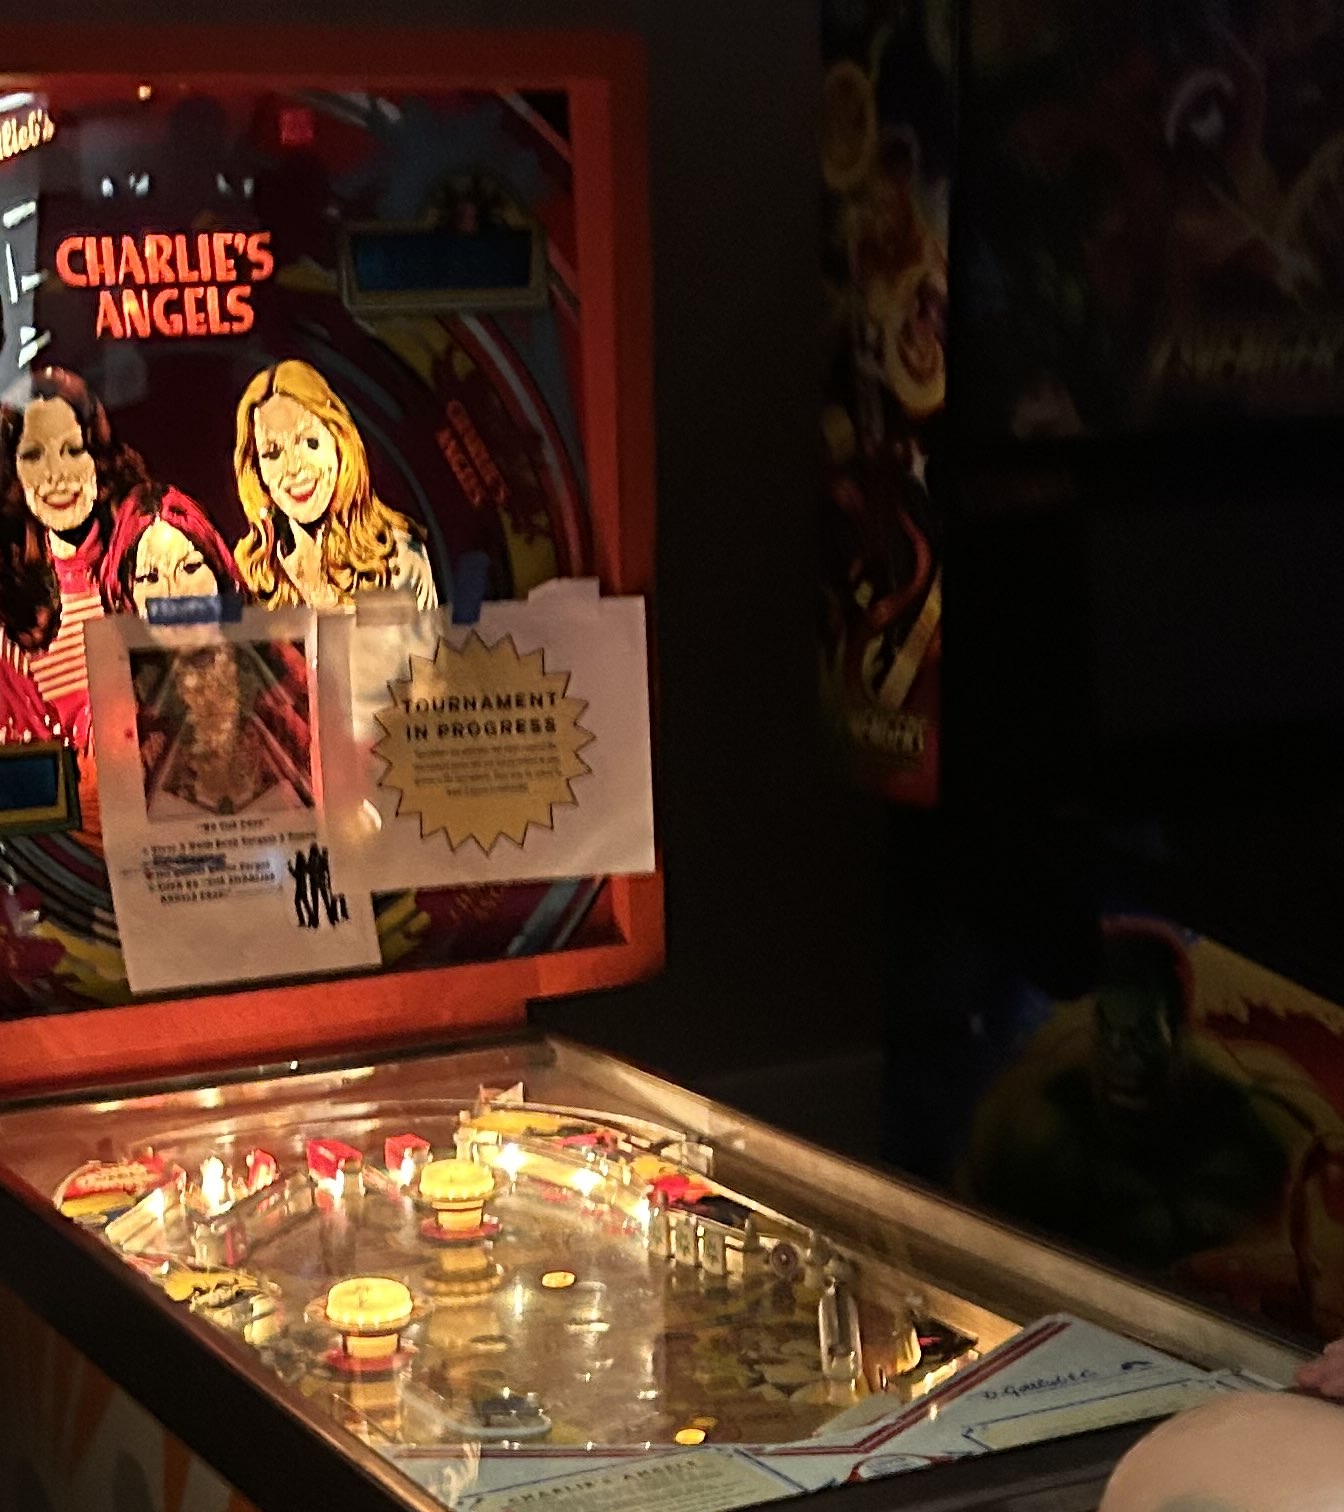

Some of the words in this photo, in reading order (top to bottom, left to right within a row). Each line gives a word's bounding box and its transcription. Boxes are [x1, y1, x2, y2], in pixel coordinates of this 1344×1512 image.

[55, 231, 275, 288] CHARLIE'S
[96, 285, 255, 341] ANGELS
[402, 691, 557, 715] TOURNAMENT
[406, 723, 429, 742] IN
[437, 718, 557, 739] PROGRESS
